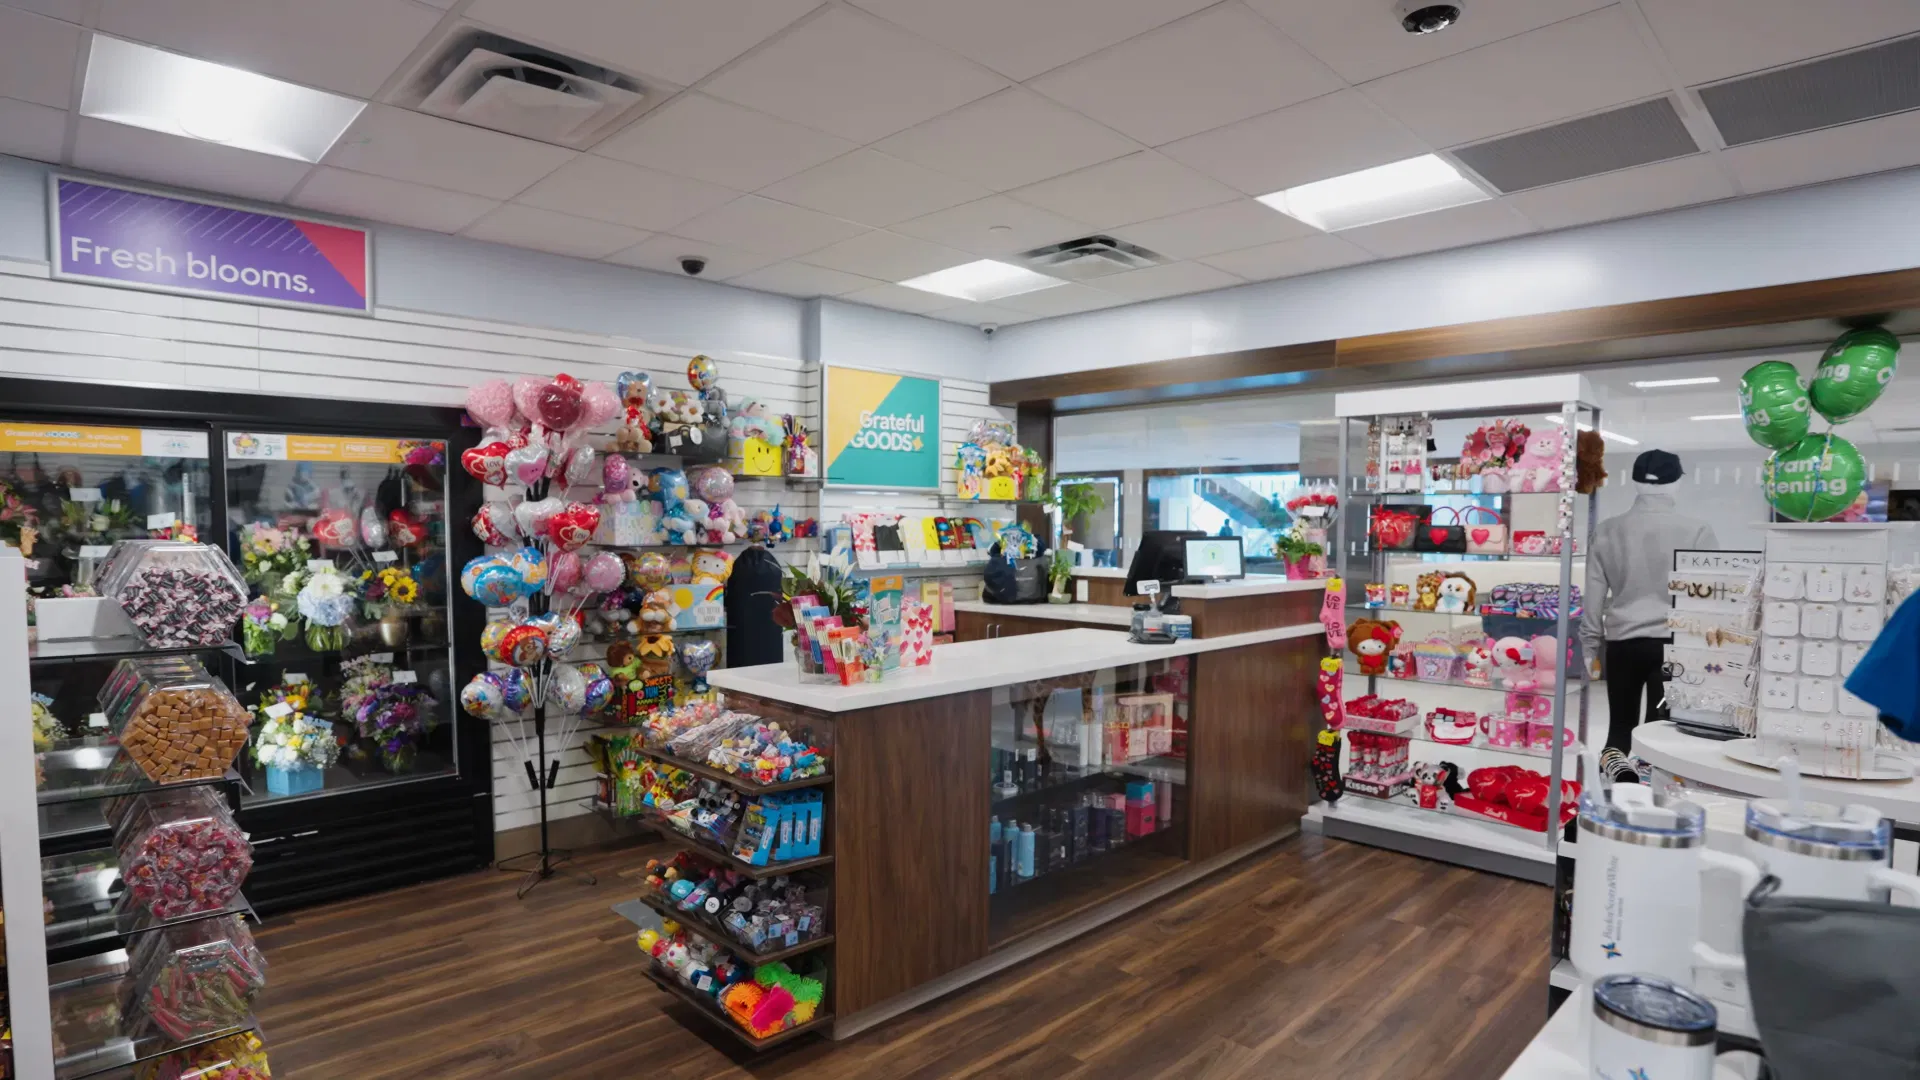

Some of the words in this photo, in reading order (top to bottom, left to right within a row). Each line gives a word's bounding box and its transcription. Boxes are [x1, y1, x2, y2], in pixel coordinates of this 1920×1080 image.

[71, 236, 177, 275] Fresh
[187, 252, 316, 294] blooms.
[860, 409, 925, 434] Grateful
[850, 429, 913, 452] GOODS
